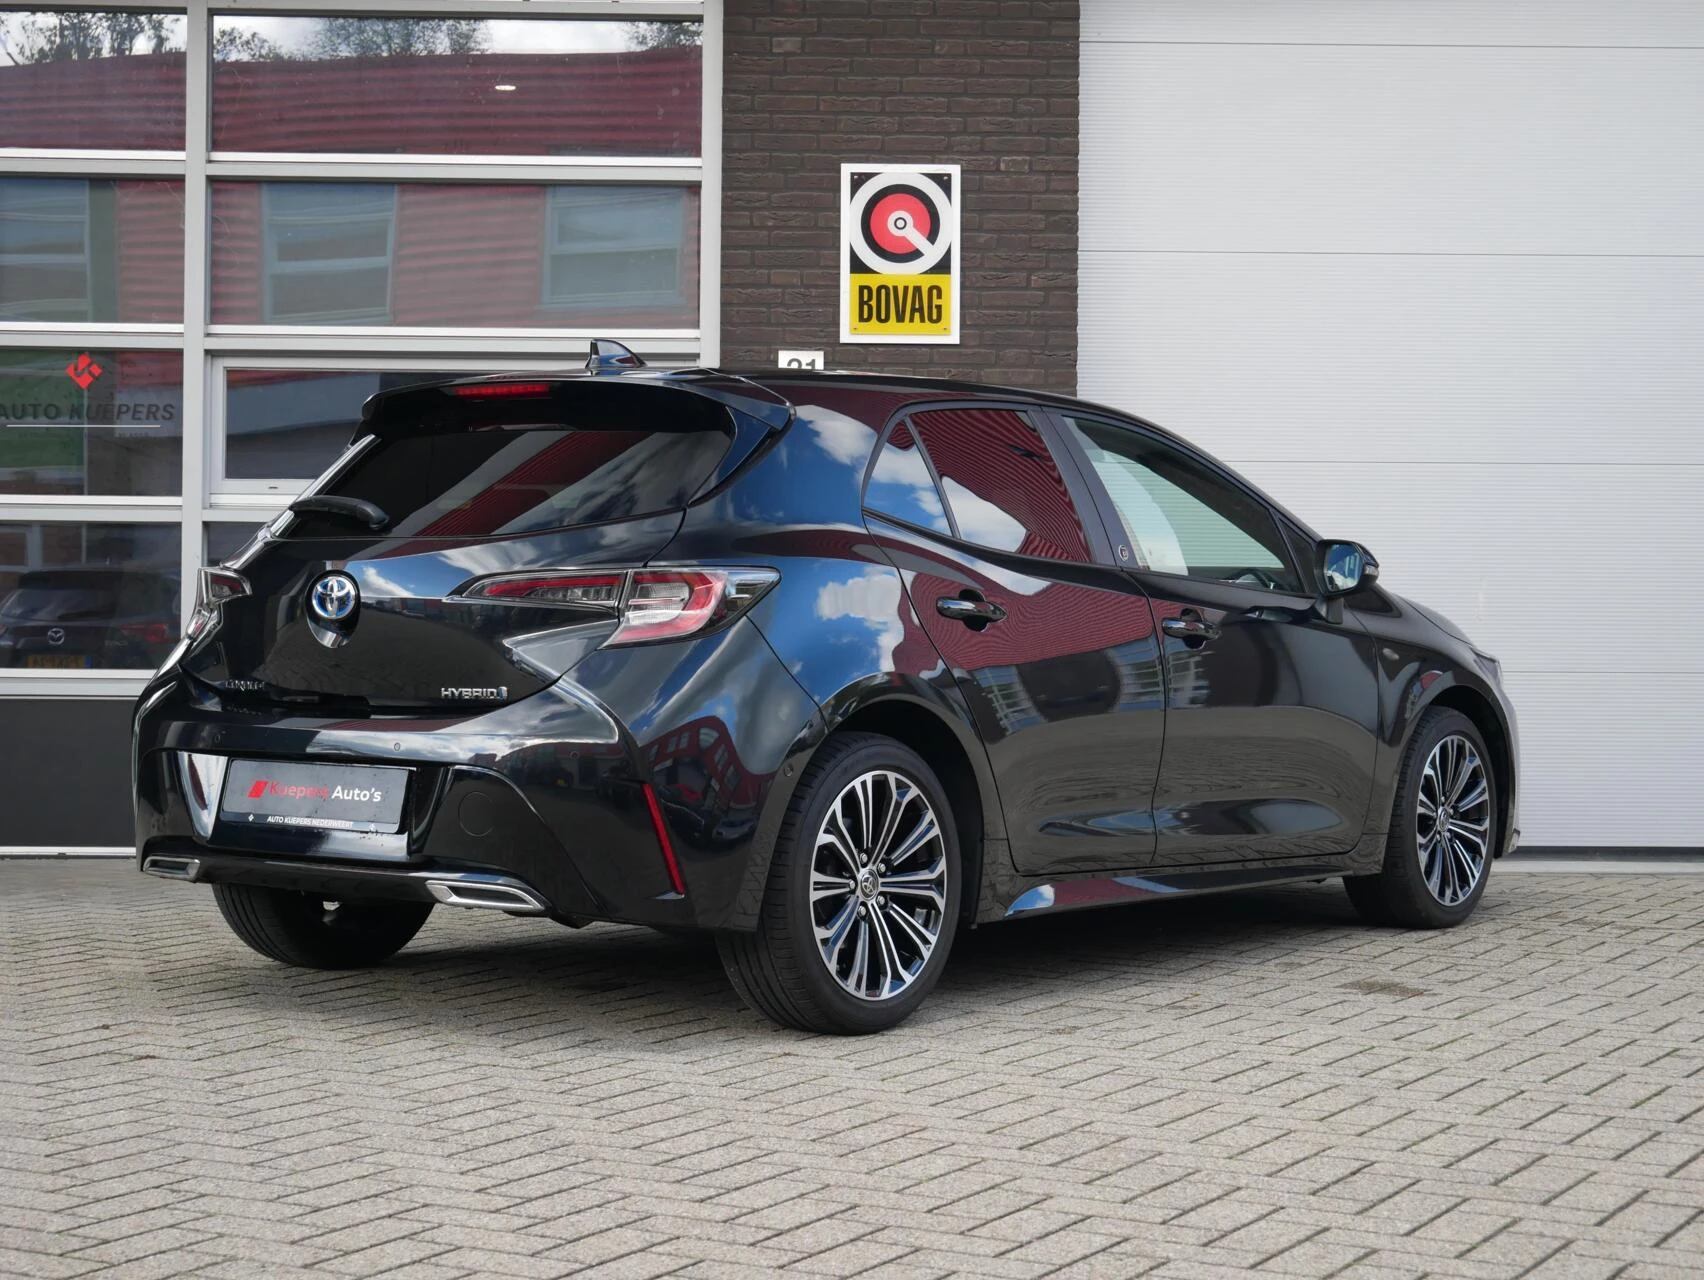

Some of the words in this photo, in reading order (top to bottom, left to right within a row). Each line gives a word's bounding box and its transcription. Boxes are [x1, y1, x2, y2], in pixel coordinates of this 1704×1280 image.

[858, 284, 943, 324] BOVAG
[0, 403, 61, 421] AUTO
[69, 403, 175, 421] KUEPERS
[441, 687, 497, 698] HYBRID
[331, 785, 382, 802] Auto's
[267, 815, 284, 823] AUTO
[284, 816, 312, 825] KUEPERS
